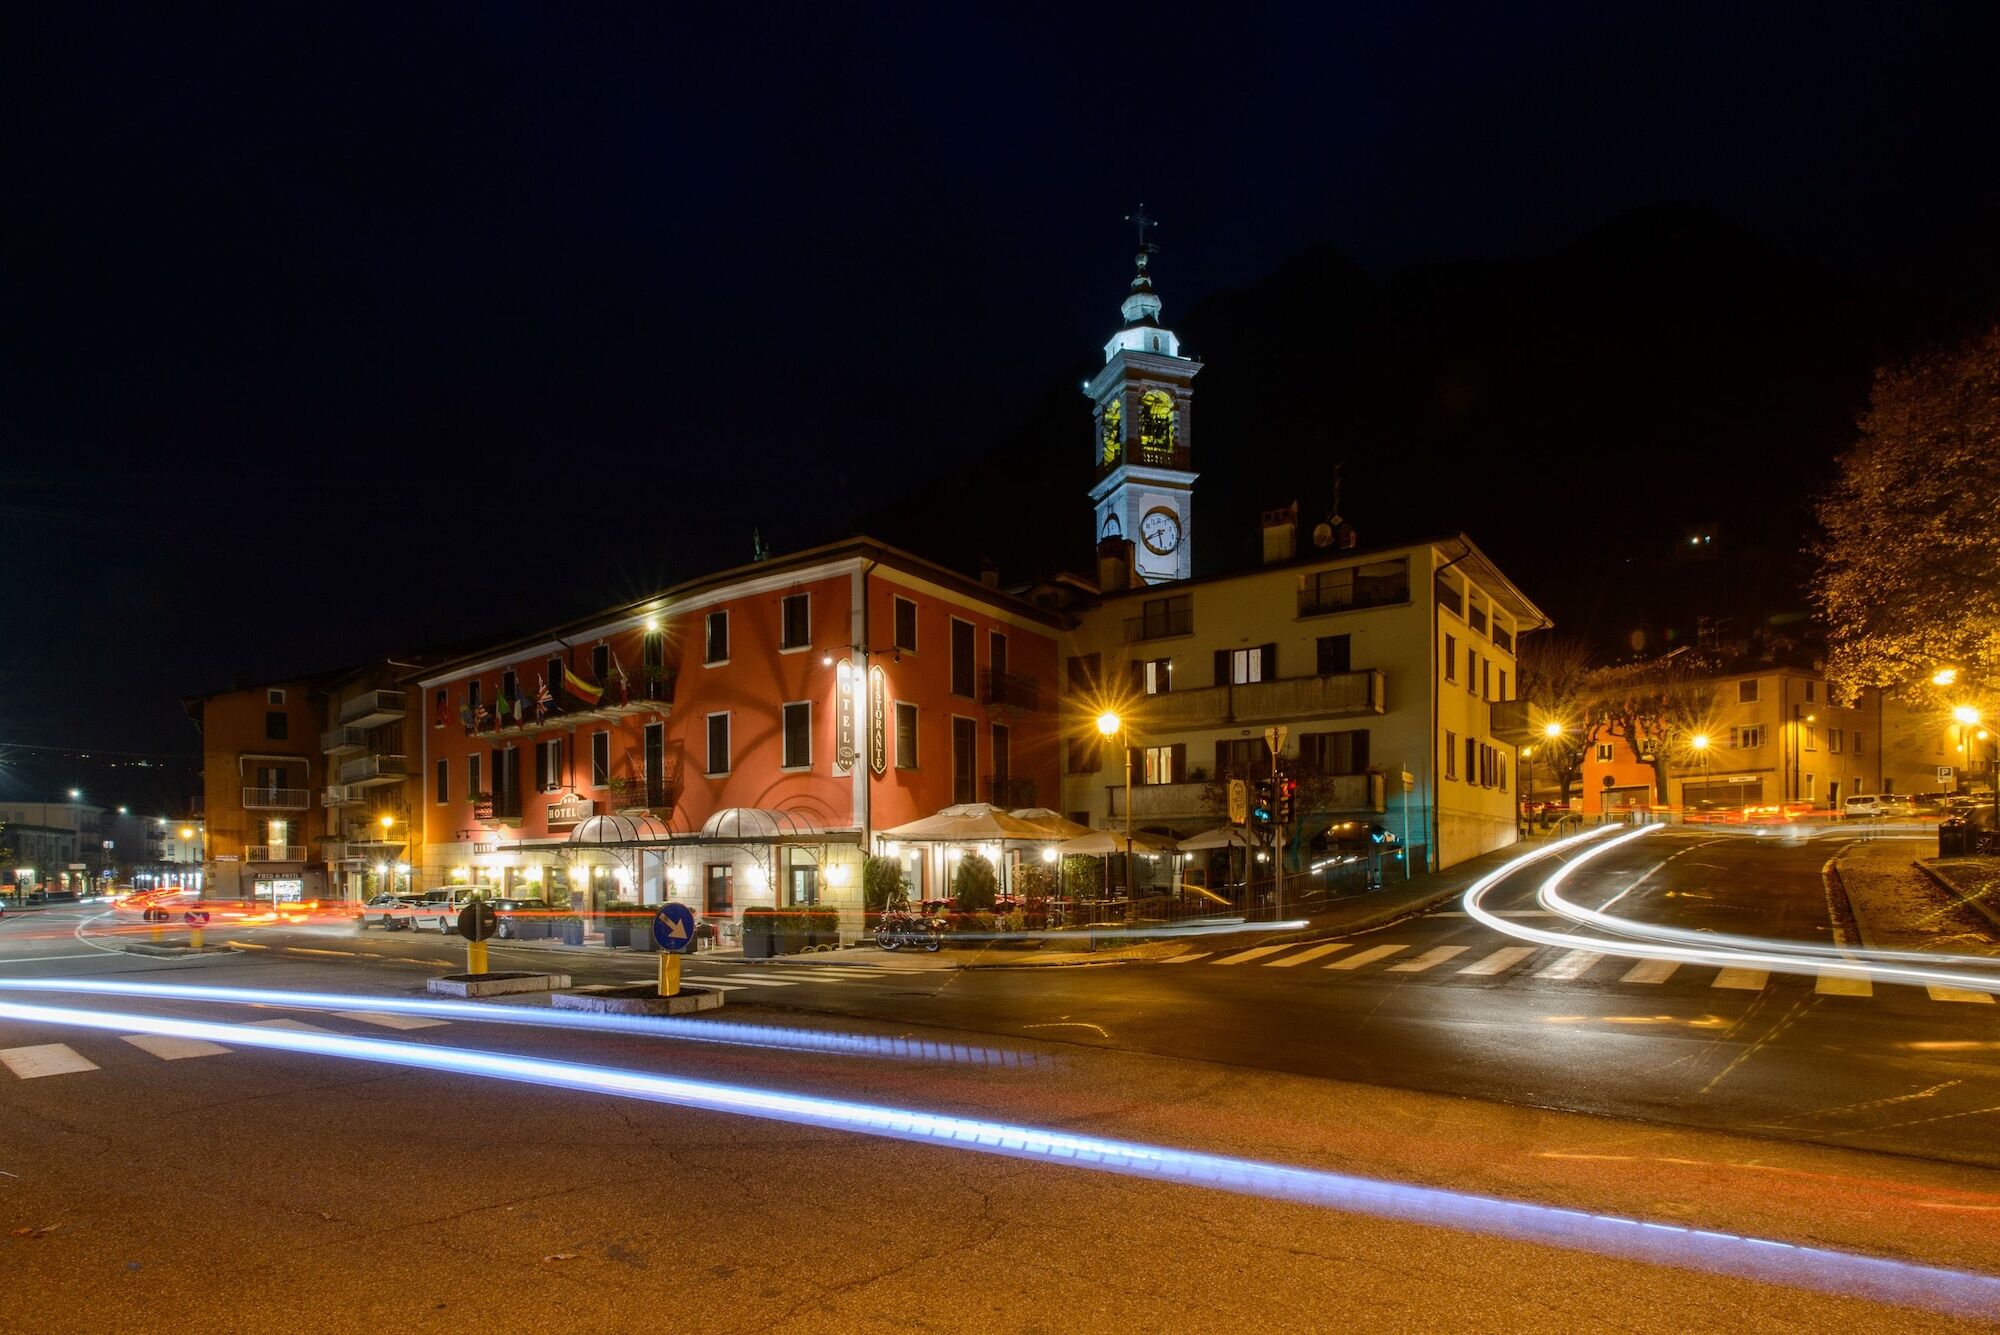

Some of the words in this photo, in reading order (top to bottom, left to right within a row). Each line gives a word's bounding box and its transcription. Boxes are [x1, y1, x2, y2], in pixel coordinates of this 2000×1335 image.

[842, 672, 851, 743] OTEL
[875, 670, 883, 769] RISTORANTE
[548, 807, 577, 819] HOTEL
